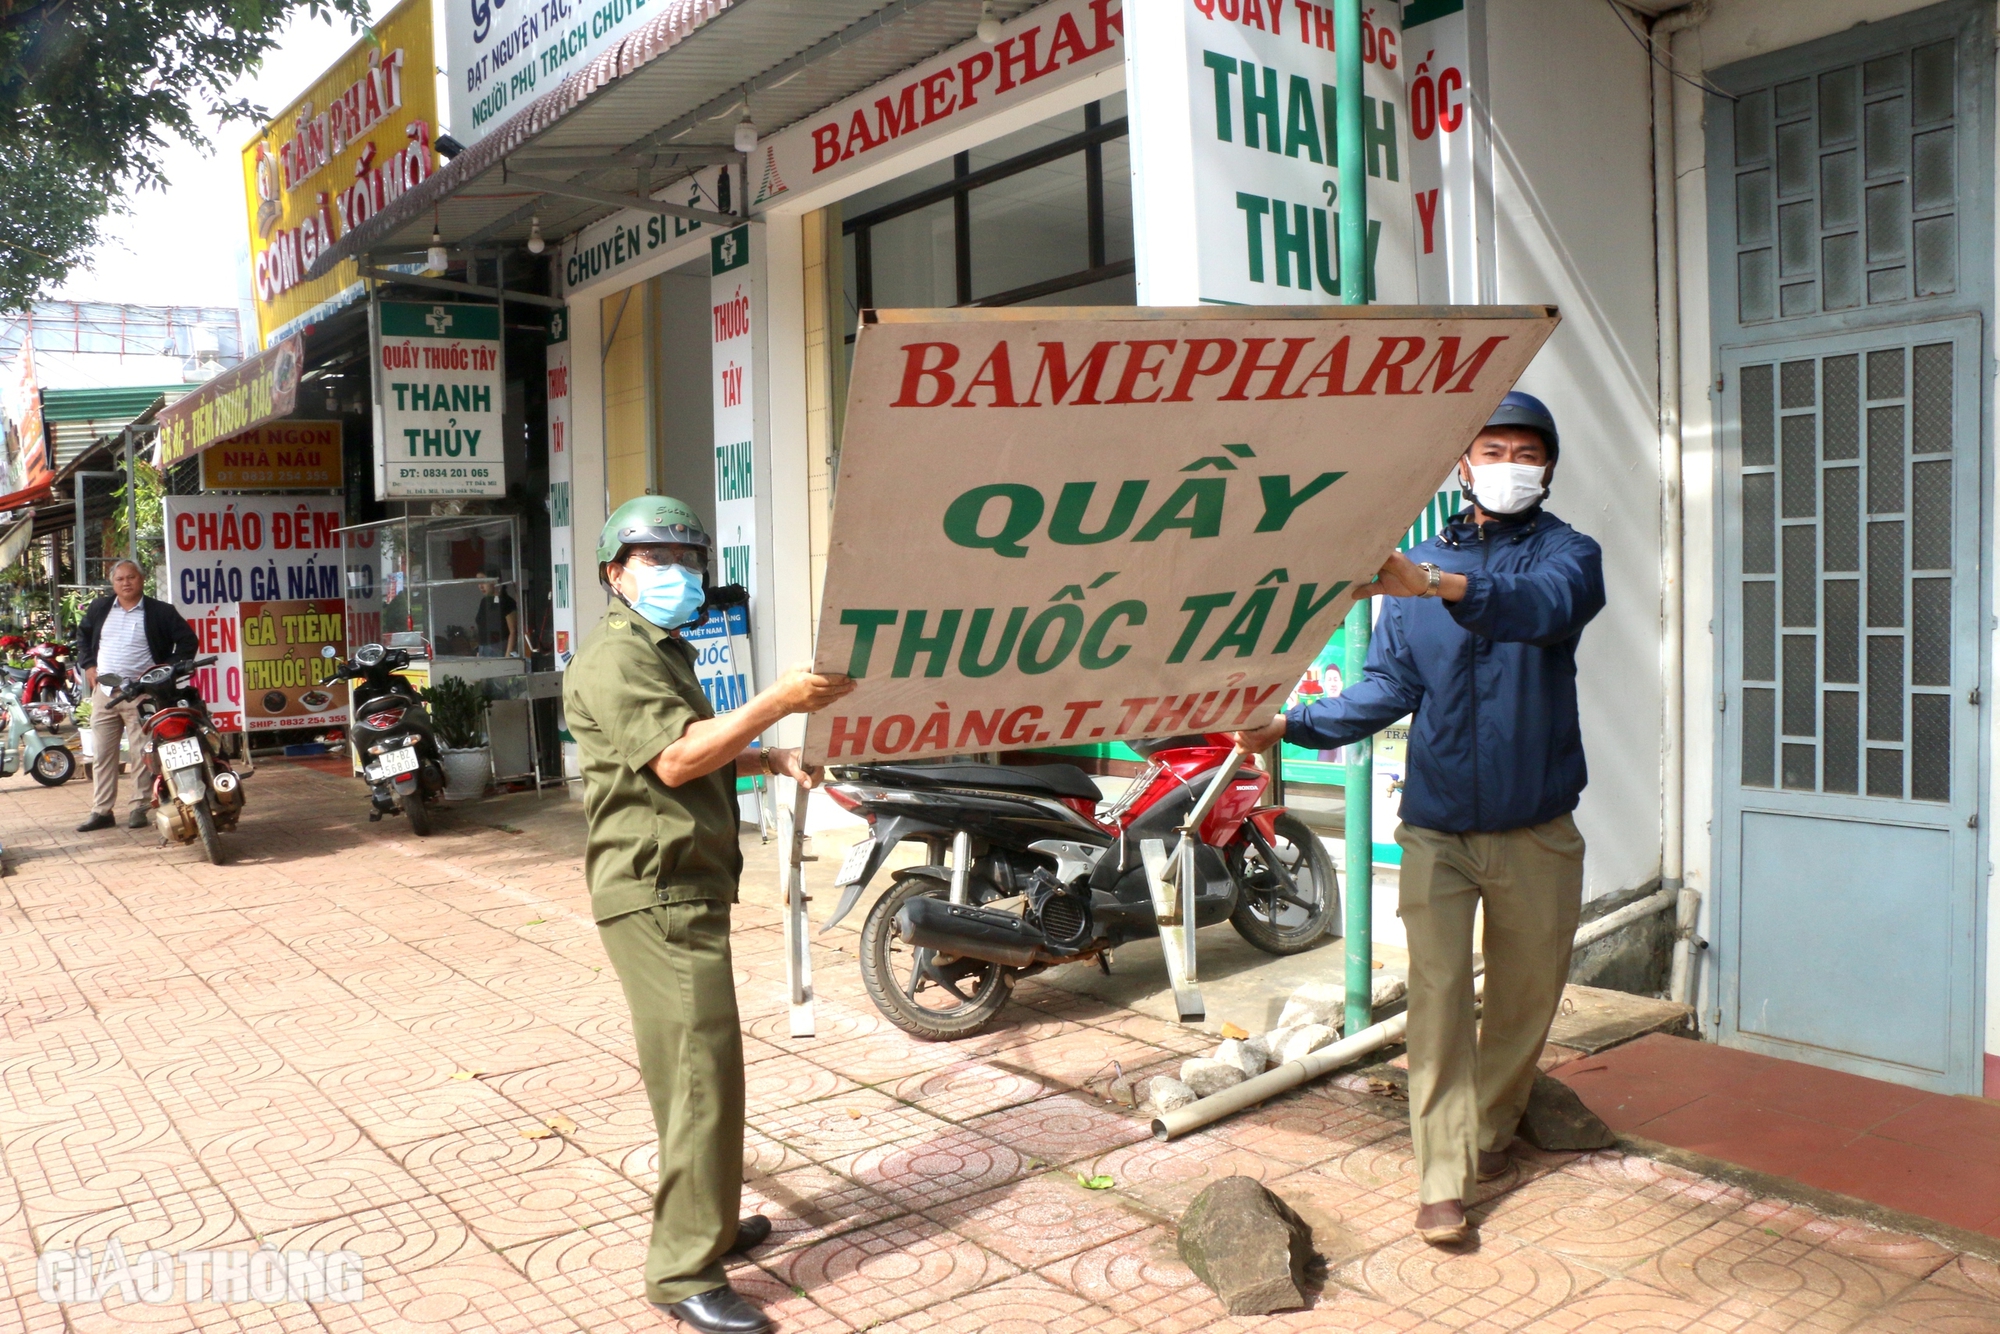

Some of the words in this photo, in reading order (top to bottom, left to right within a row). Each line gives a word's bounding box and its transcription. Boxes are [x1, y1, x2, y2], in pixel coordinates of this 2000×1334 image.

[467, 61, 488, 93] ĐẠT
[491, 15, 539, 74] NGUYÊN
[1295, 1, 1397, 70] THỐC
[472, 83, 508, 130] NGƯỜI
[511, 67, 536, 99] PHỤ
[540, 21, 588, 78] TRÁCH
[811, 0, 1124, 174] BAMEPHAR
[331, 48, 404, 156] PHÁT
[256, 227, 303, 302] CƠM
[301, 192, 335, 272] GÀ
[336, 142, 383, 241] XỐI
[567, 225, 640, 287] CHUYÊN
[675, 183, 701, 238] LẺ
[713, 283, 749, 342] THUỐC
[382, 340, 420, 370] QUẦY
[423, 342, 469, 370] THUỐC
[471, 345, 497, 371] TÂY
[547, 356, 568, 400] THUỐC
[890, 336, 1509, 408] BAMEPHARM
[391, 383, 491, 412] THANH
[722, 360, 743, 408] TÂY
[224, 448, 270, 467] NHÀ
[277, 447, 320, 467] NẤU
[267, 430, 331, 445] NGON
[403, 418, 481, 457] THỦY
[552, 415, 564, 453] TÂY
[241, 471, 273, 481] 0832
[279, 471, 301, 481] 254
[306, 471, 328, 481] 355
[400, 469, 420, 478] ĐT:
[423, 468, 447, 478] 0834
[450, 468, 467, 478] 201
[471, 468, 489, 478] 065
[716, 440, 753, 501] THANH
[551, 481, 570, 527] THANH
[942, 443, 1349, 558] QUẦY
[175, 504, 262, 552] CHÁO
[272, 503, 341, 549] ĐÊM
[180, 560, 243, 604] CHÁO
[251, 559, 281, 601] GÀ
[287, 553, 339, 600] NẤM
[244, 611, 277, 646] GÀ
[282, 603, 343, 644] TIỀM
[690, 628, 704, 637] VIỆT
[706, 626, 722, 634] NAM
[839, 572, 1147, 680] THUỐC
[1165, 568, 1353, 665] TÂY
[245, 647, 306, 690] THUỐC
[697, 641, 729, 666] UỐC
[250, 720, 277, 729] SHIP:
[280, 718, 305, 727] 0832
[308, 716, 326, 724] 254
[329, 714, 347, 723] 355
[1384, 730, 1409, 739] TRA
